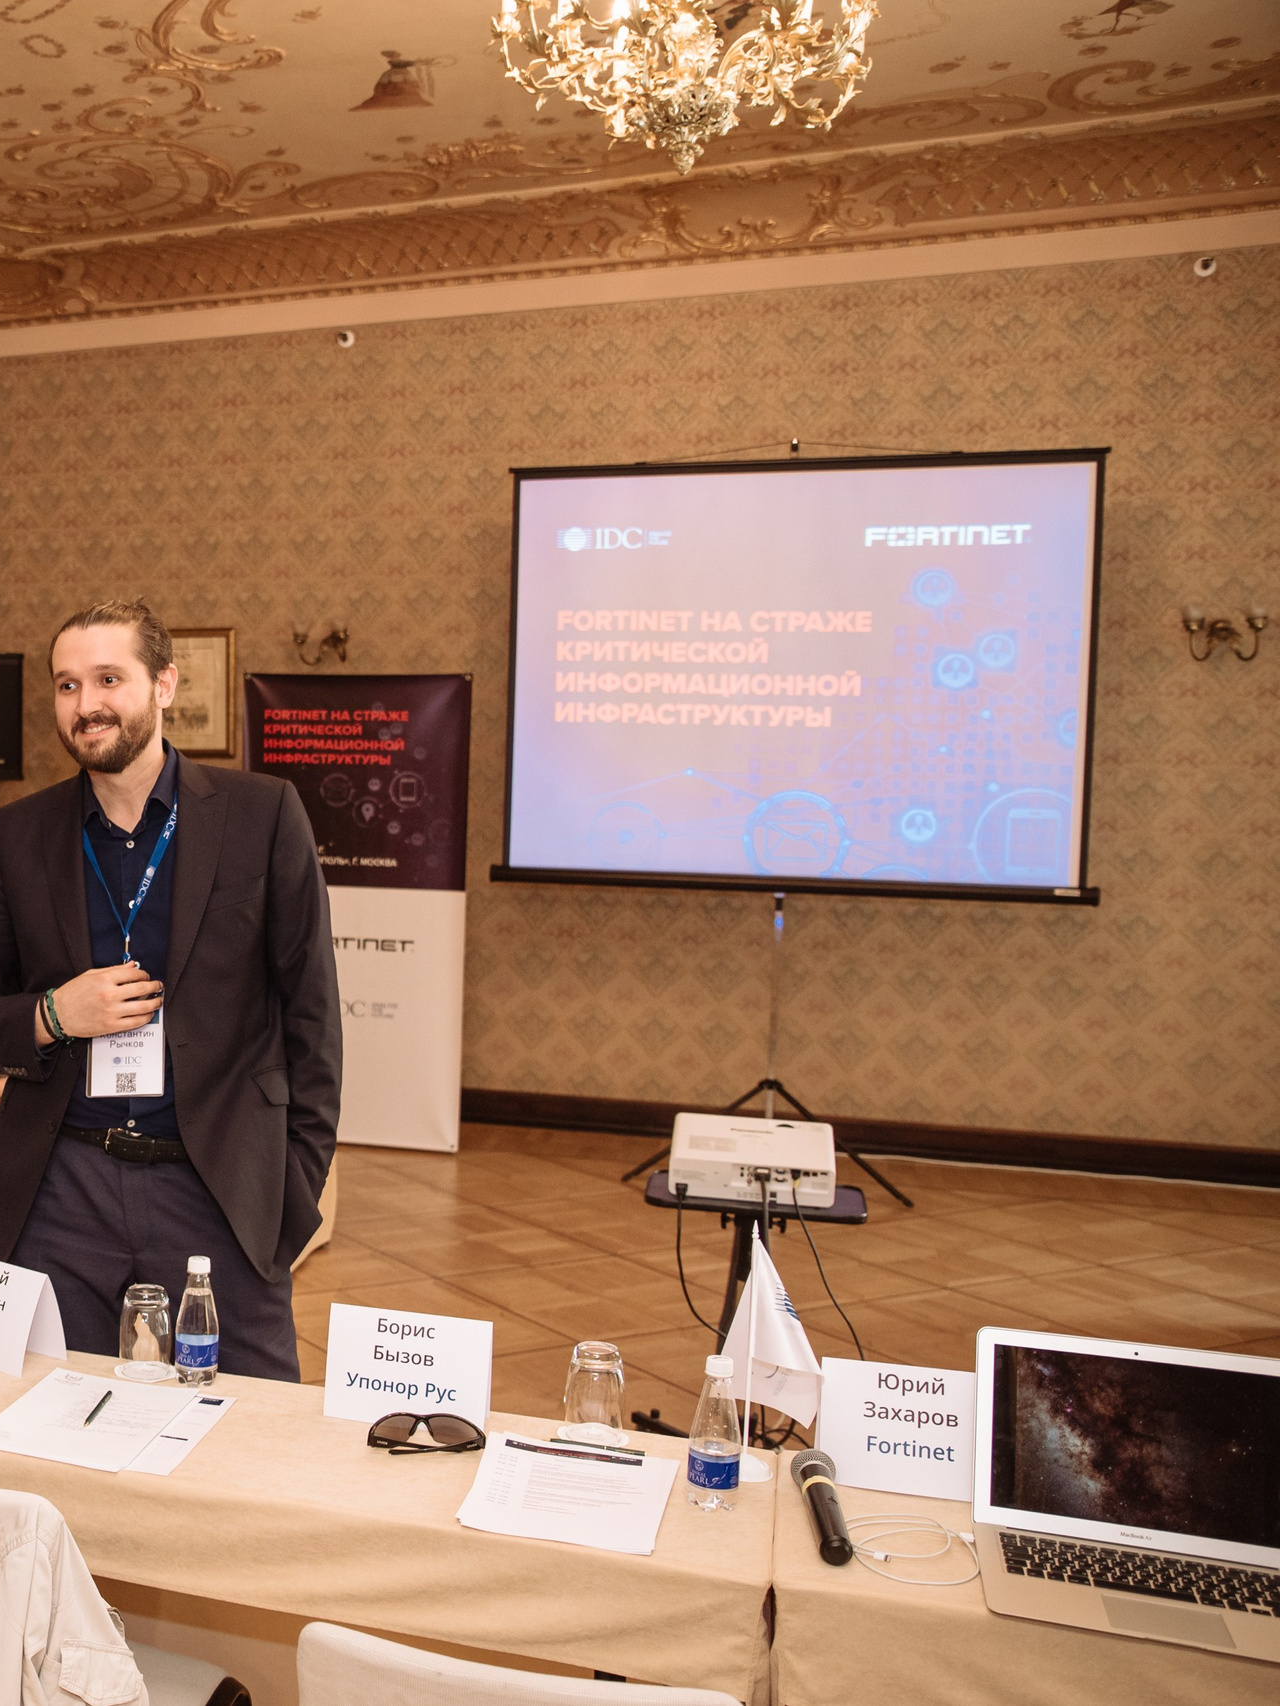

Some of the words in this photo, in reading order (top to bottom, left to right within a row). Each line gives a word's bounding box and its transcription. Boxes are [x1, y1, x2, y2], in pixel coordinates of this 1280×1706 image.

[595, 526, 643, 549] IDC
[865, 524, 1032, 547] FORTINET
[557, 610, 693, 632] FORTINET
[700, 610, 743, 632] НА
[749, 610, 872, 633] СТРАЖЕ
[556, 637, 769, 663] КРИТИЧЕСКОЙ
[555, 669, 861, 698] ИНФОРМАЦИОННОЙ
[264, 709, 328, 721] FORTINET
[331, 710, 350, 721] НА
[353, 710, 409, 722] СТРАЖЕ
[554, 701, 832, 727] ИНФРАСТРУКТУРЫ
[263, 723, 363, 735] КРИТИЧЕСКОЙ
[263, 738, 405, 751] ИНФОРМАЦИОННОЙ
[263, 753, 391, 766] ИНФРАСТРУКТУРЫ
[166, 813, 177, 831] IDC
[360, 857, 398, 867] МОСКВА
[139, 878, 150, 897] IDC
[109, 1040, 144, 1048] Рычков
[124, 1056, 142, 1065] IDC
[377, 1318, 436, 1340] Борис
[373, 1345, 434, 1367] Бызов
[346, 1372, 419, 1400] Упонор
[425, 1383, 457, 1404] Рус
[878, 1372, 945, 1397] Юрий
[863, 1401, 959, 1428] Захаров
[867, 1435, 955, 1462] Fortinet
[1120, 1531, 1144, 1540] MacBook
